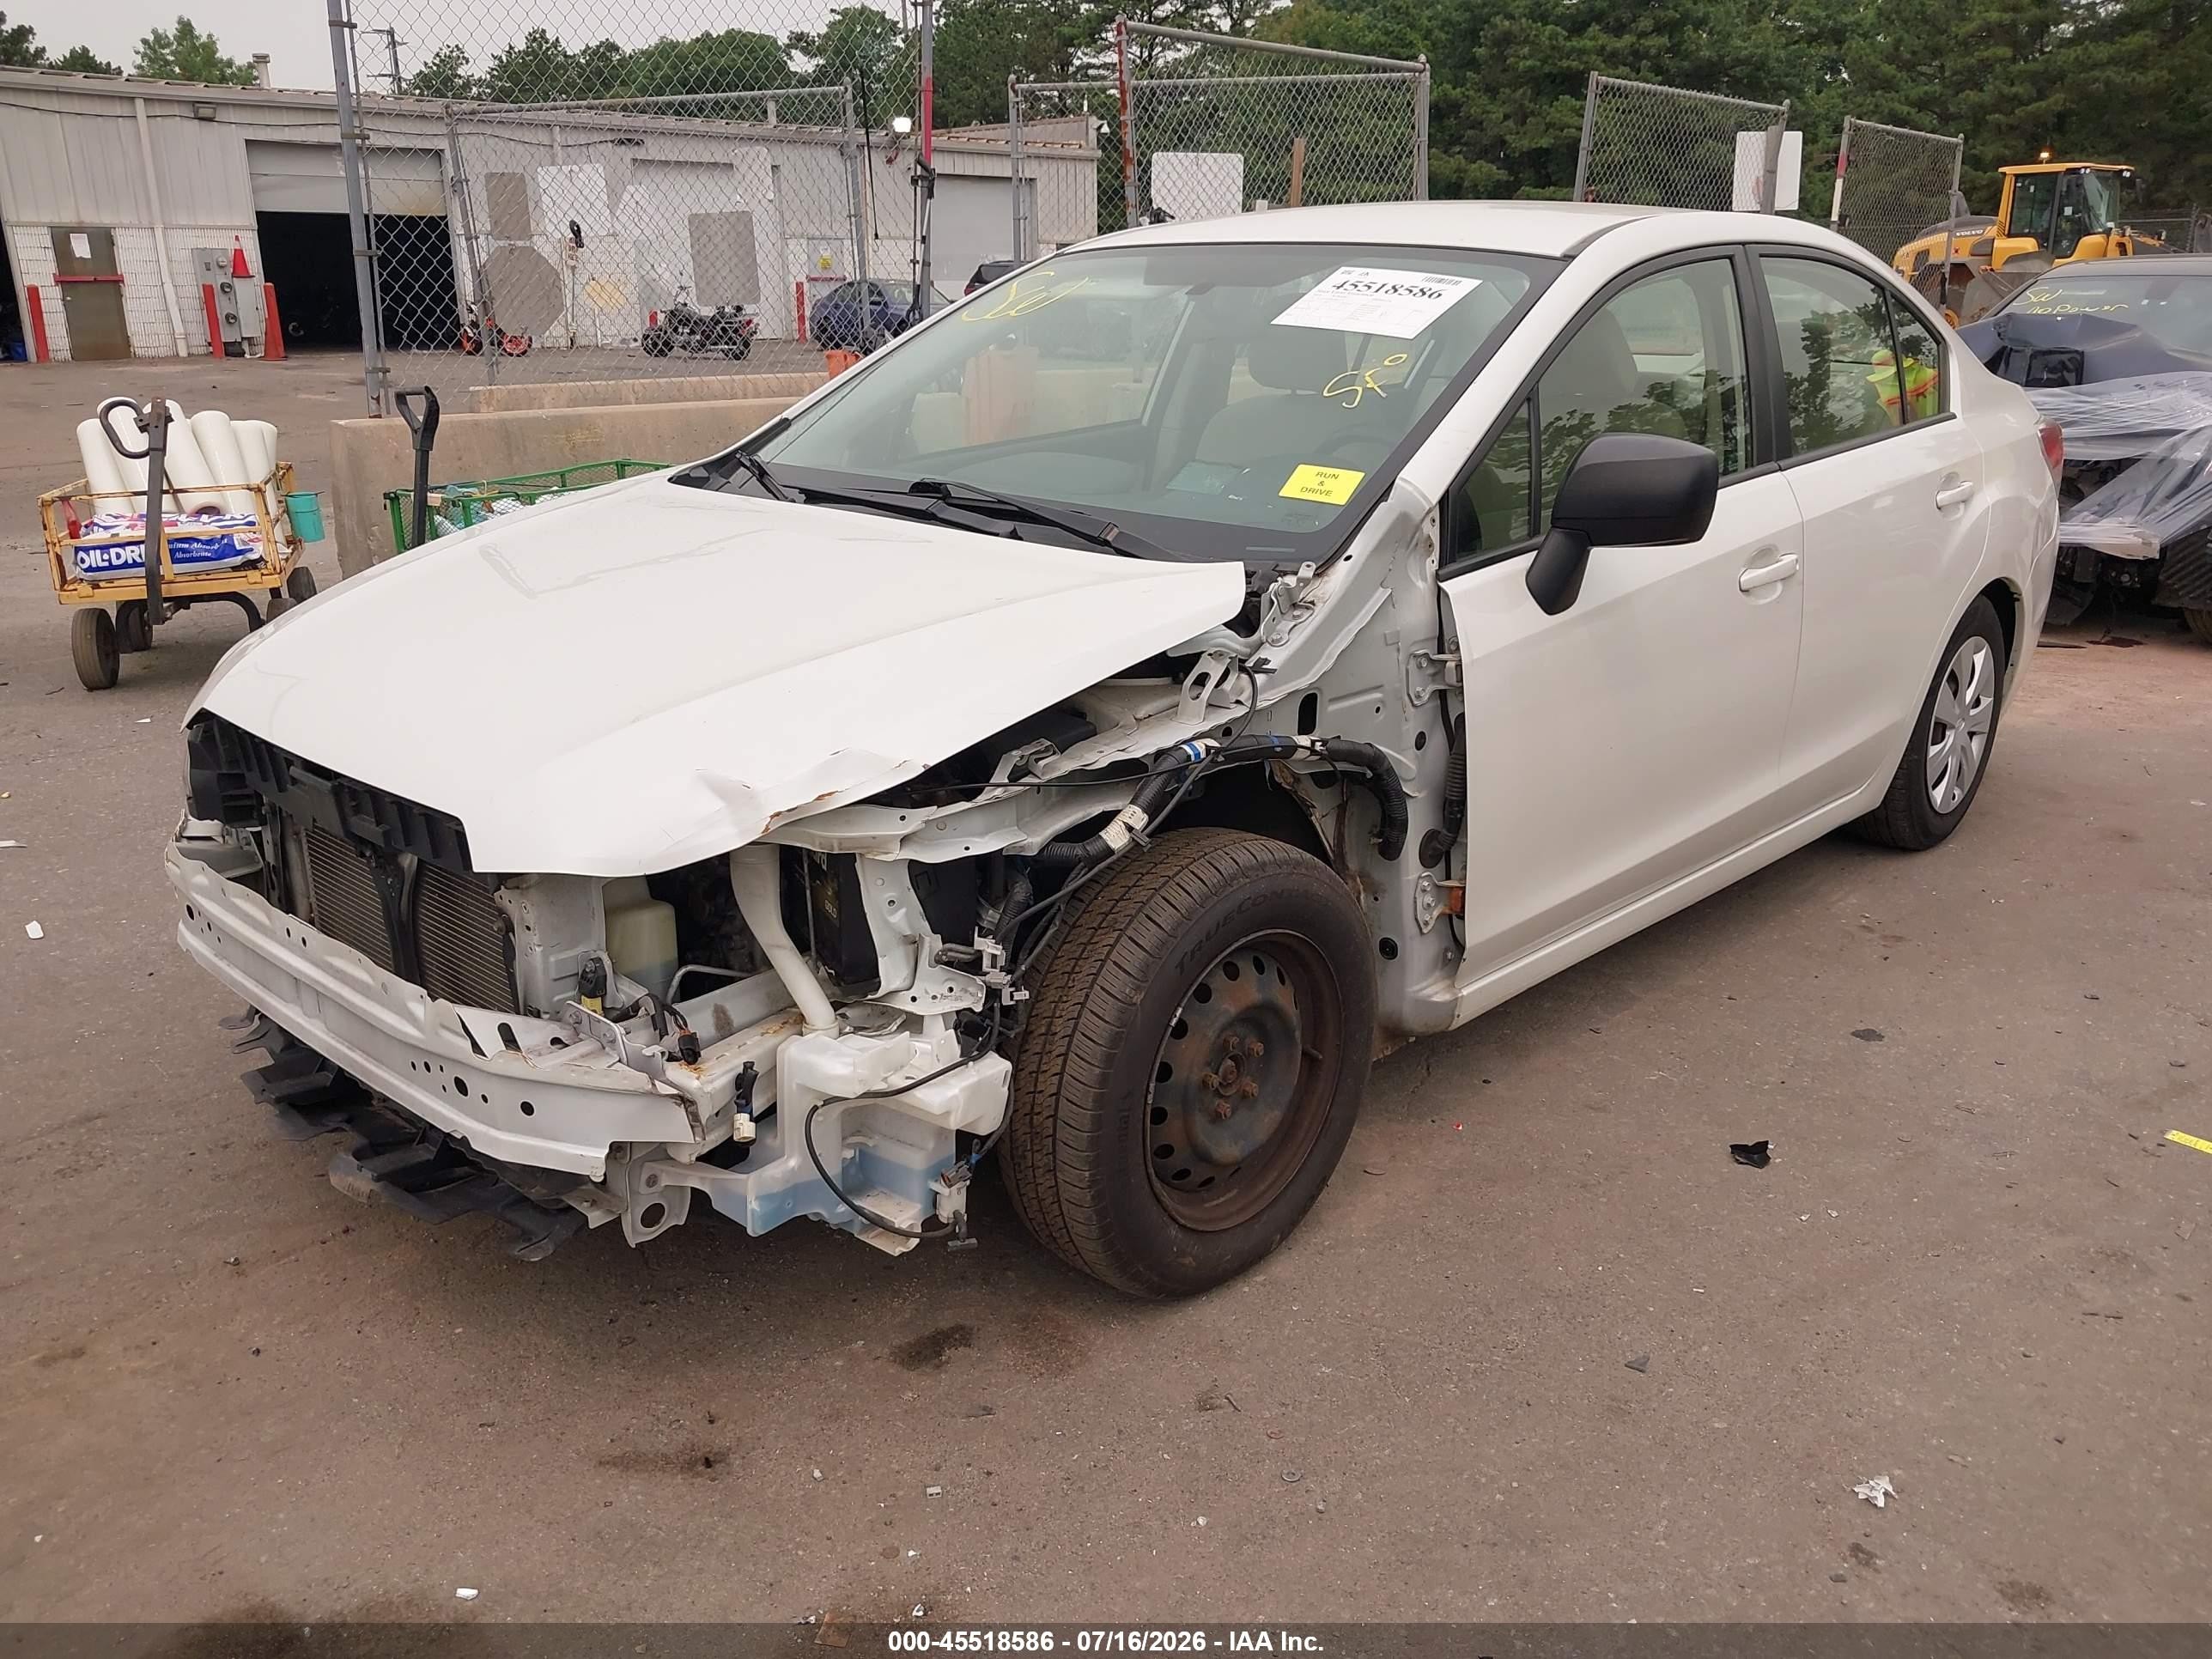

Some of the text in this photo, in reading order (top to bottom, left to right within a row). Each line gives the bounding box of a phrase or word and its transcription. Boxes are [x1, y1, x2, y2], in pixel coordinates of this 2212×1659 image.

[1332, 279, 1444, 301] 45518586
[1315, 471, 1340, 480] RUN
[1300, 486, 1334, 496] DRIVE
